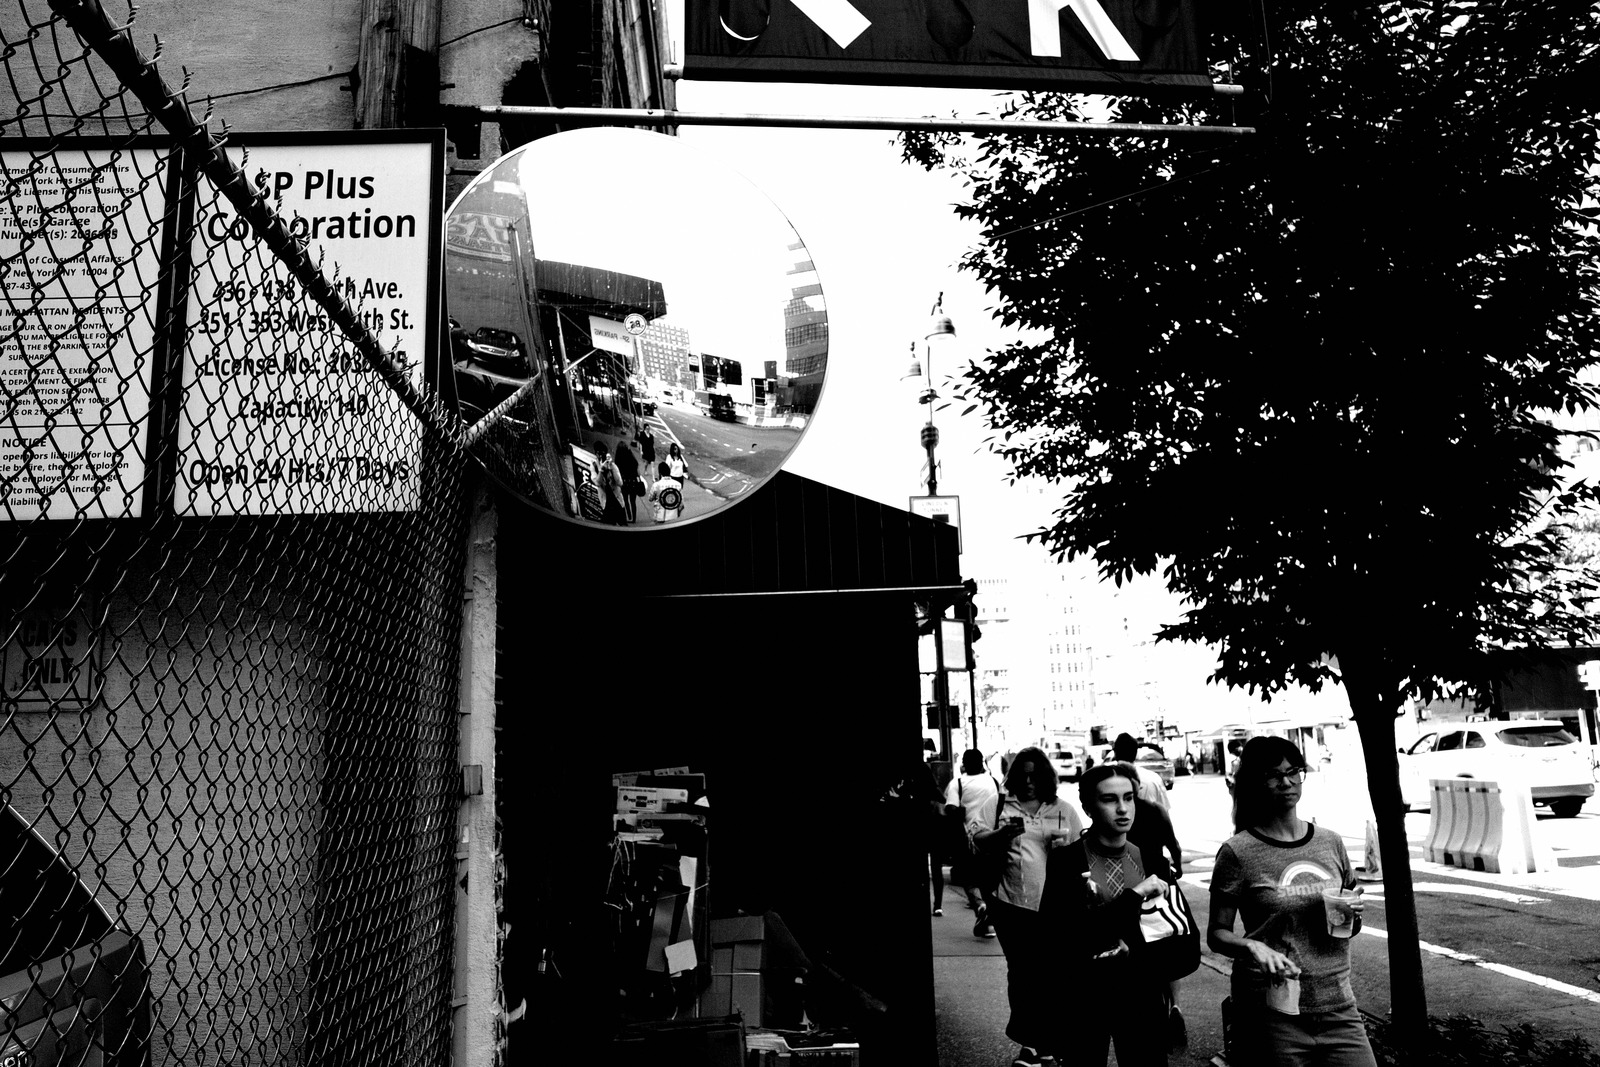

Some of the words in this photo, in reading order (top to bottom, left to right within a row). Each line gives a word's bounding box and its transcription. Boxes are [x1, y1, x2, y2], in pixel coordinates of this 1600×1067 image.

[50, 165, 97, 174] Cnsume
[254, 170, 293, 200] SP
[304, 169, 375, 200] Plus
[49, 217, 90, 228] Garage
[207, 207, 416, 243] Cooration
[29, 256, 40, 264] of
[82, 267, 108, 276] 10004
[213, 281, 246, 302] 436
[262, 279, 296, 302] 438
[362, 277, 403, 300] Ave.
[54, 323, 67, 331] ON
[76, 322, 114, 331] ONTHY
[198, 312, 230, 334] 351
[248, 311, 281, 333] 353
[389, 308, 414, 330] St.
[57, 343, 90, 351] ARKING
[92, 342, 107, 350] TAX
[203, 353, 278, 377] License
[8, 378, 60, 386] DEPAMENT
[238, 393, 328, 426] Capacity:
[337, 393, 368, 417] 140
[2, 437, 47, 448] NOTICE
[87, 450, 102, 459] for
[190, 458, 249, 494] Open
[256, 458, 281, 485] 24
[355, 456, 410, 489] Days
[25, 485, 56, 496] modif
